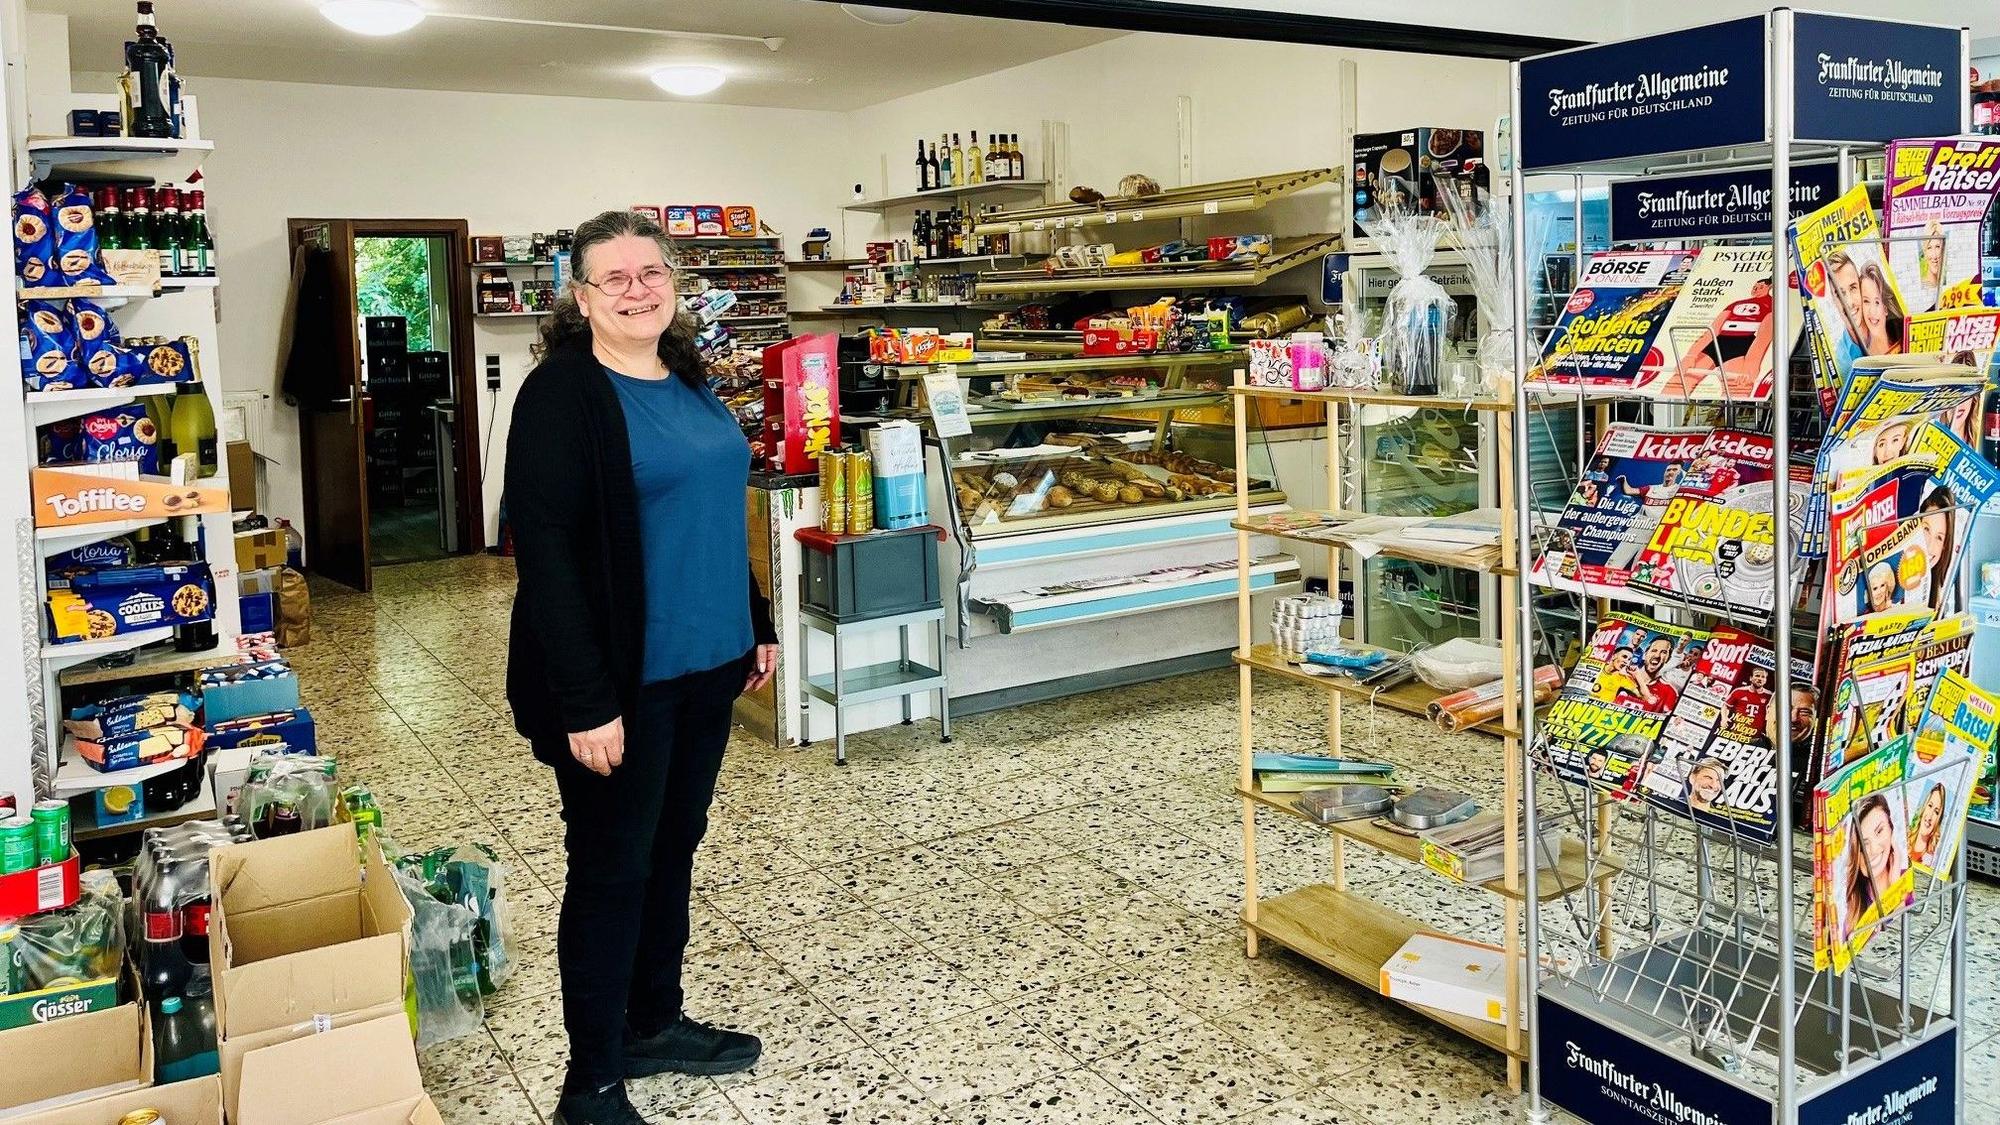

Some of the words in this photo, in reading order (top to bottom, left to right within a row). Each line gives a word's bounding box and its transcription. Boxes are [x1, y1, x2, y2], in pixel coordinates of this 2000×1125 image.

[1818, 52, 1884, 85] Frankfurter
[1884, 58, 1942, 90] Allgemeine
[1548, 81, 1635, 117] Frankfurter
[1635, 65, 1729, 104] Allgemeine
[1828, 87, 1863, 99] ZEITUNG
[1864, 88, 1879, 100] FÜR
[1881, 90, 1933, 104] DEUTSCHLAND
[1562, 112, 1606, 126] ZEITUNG
[1608, 107, 1629, 120] FÜR
[1631, 95, 1713, 116] DEUTSCHLAND
[1936, 147, 2000, 169] Profi
[1923, 164, 2000, 191] Rätsel
[1637, 188, 1725, 219] Frankfurter
[1725, 180, 1821, 213] Allgeeine
[1893, 194, 1967, 213] SAMMELBAND
[1651, 216, 1696, 228] ZEITUNG
[1698, 213, 1719, 226] FÜR
[1722, 209, 1804, 224] DEUTSCHND
[1588, 259, 1651, 275] BÖRSE
[1713, 251, 1774, 262] PSYCHO
[1368, 277, 1386, 289] Hier
[1594, 275, 1643, 284] ONLINE
[1692, 278, 1734, 288] Außen
[1691, 287, 1725, 296] stark.
[1568, 316, 1652, 335] Goldene
[1947, 315, 1998, 336] RÄTSEL
[1555, 333, 1645, 355] Chancen
[1947, 333, 1996, 354] KAISER
[1591, 353, 1613, 362] Fonds
[1613, 355, 1629, 363] und
[1594, 361, 1606, 369] die
[1605, 362, 1624, 371] Rally
[96, 441, 148, 462] Gloria
[1737, 459, 1773, 470] SONDERHEF
[1953, 455, 1995, 494] Rätsel
[45, 487, 147, 518] Toffifee
[1597, 497, 1615, 511] Die
[1615, 499, 1637, 517] Liga
[1865, 495, 1896, 525] RÄTSEL
[1563, 508, 1579, 521] der
[1580, 510, 1657, 530] außergewöhnlic
[1582, 524, 1636, 543] Champions
[71, 546, 122, 562] Gloria
[118, 601, 165, 616] COOKIES
[1702, 638, 1750, 665] Sport
[1926, 643, 1950, 659] BEST
[1952, 636, 1968, 649] OF
[1711, 664, 1738, 682] Bild
[1968, 694, 1994, 714] SPECIAL
[1548, 700, 1665, 741] BUNDESLIGA
[1734, 711, 1755, 725] Kane
[1955, 702, 1995, 743] Rätsel
[1718, 727, 1752, 745] Transfers
[1734, 722, 1758, 736] Klopp
[1705, 738, 1776, 767] EBERL
[1724, 761, 1777, 788] PACK
[1720, 782, 1777, 815] AUS.
[32, 998, 93, 1022] Gösser
[1565, 1040, 1650, 1099] Frankfurter
[1882, 1076, 1938, 1124] Allgemeine
